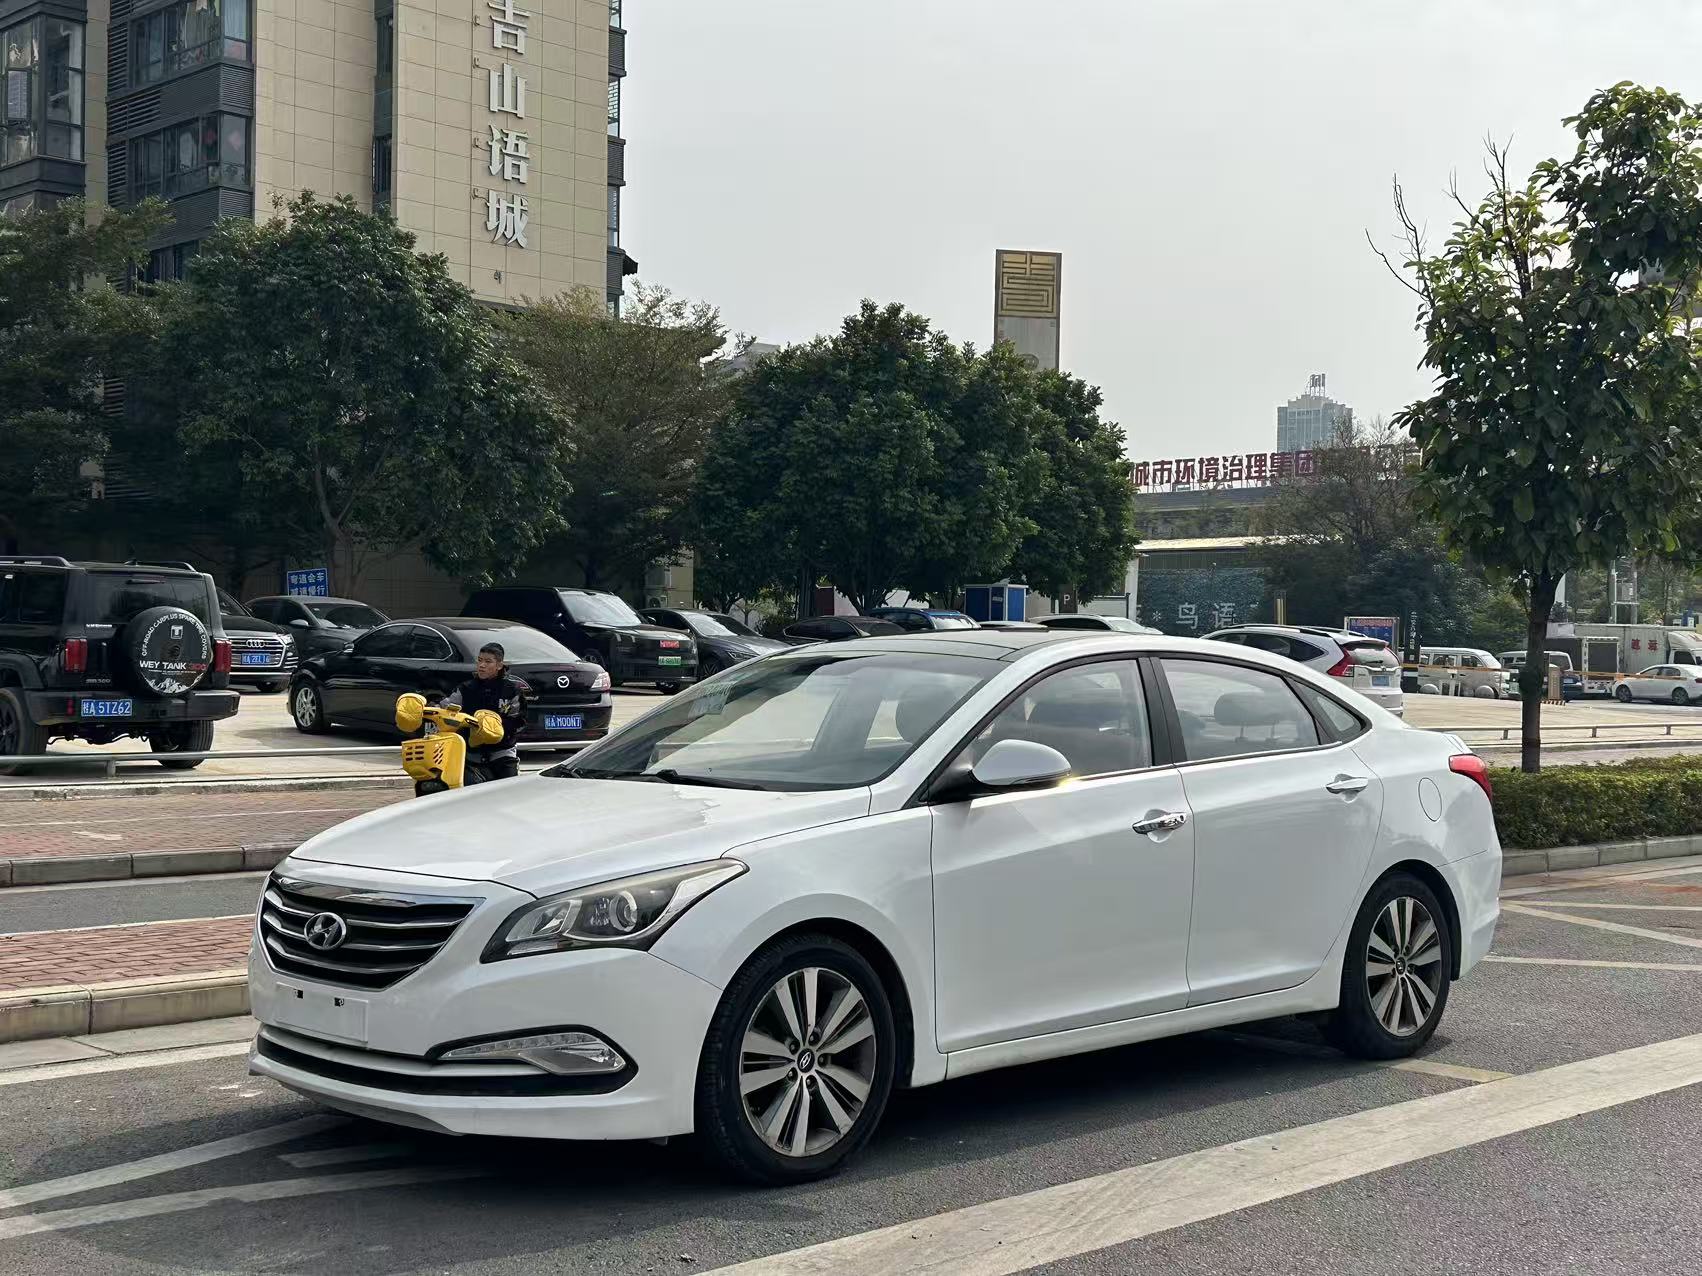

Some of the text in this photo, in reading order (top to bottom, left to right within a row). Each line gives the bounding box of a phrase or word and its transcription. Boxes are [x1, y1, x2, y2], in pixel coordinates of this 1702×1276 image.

[1063, 594, 1071, 605] P
[139, 660, 161, 668] WEY
[162, 662, 187, 670] TANK
